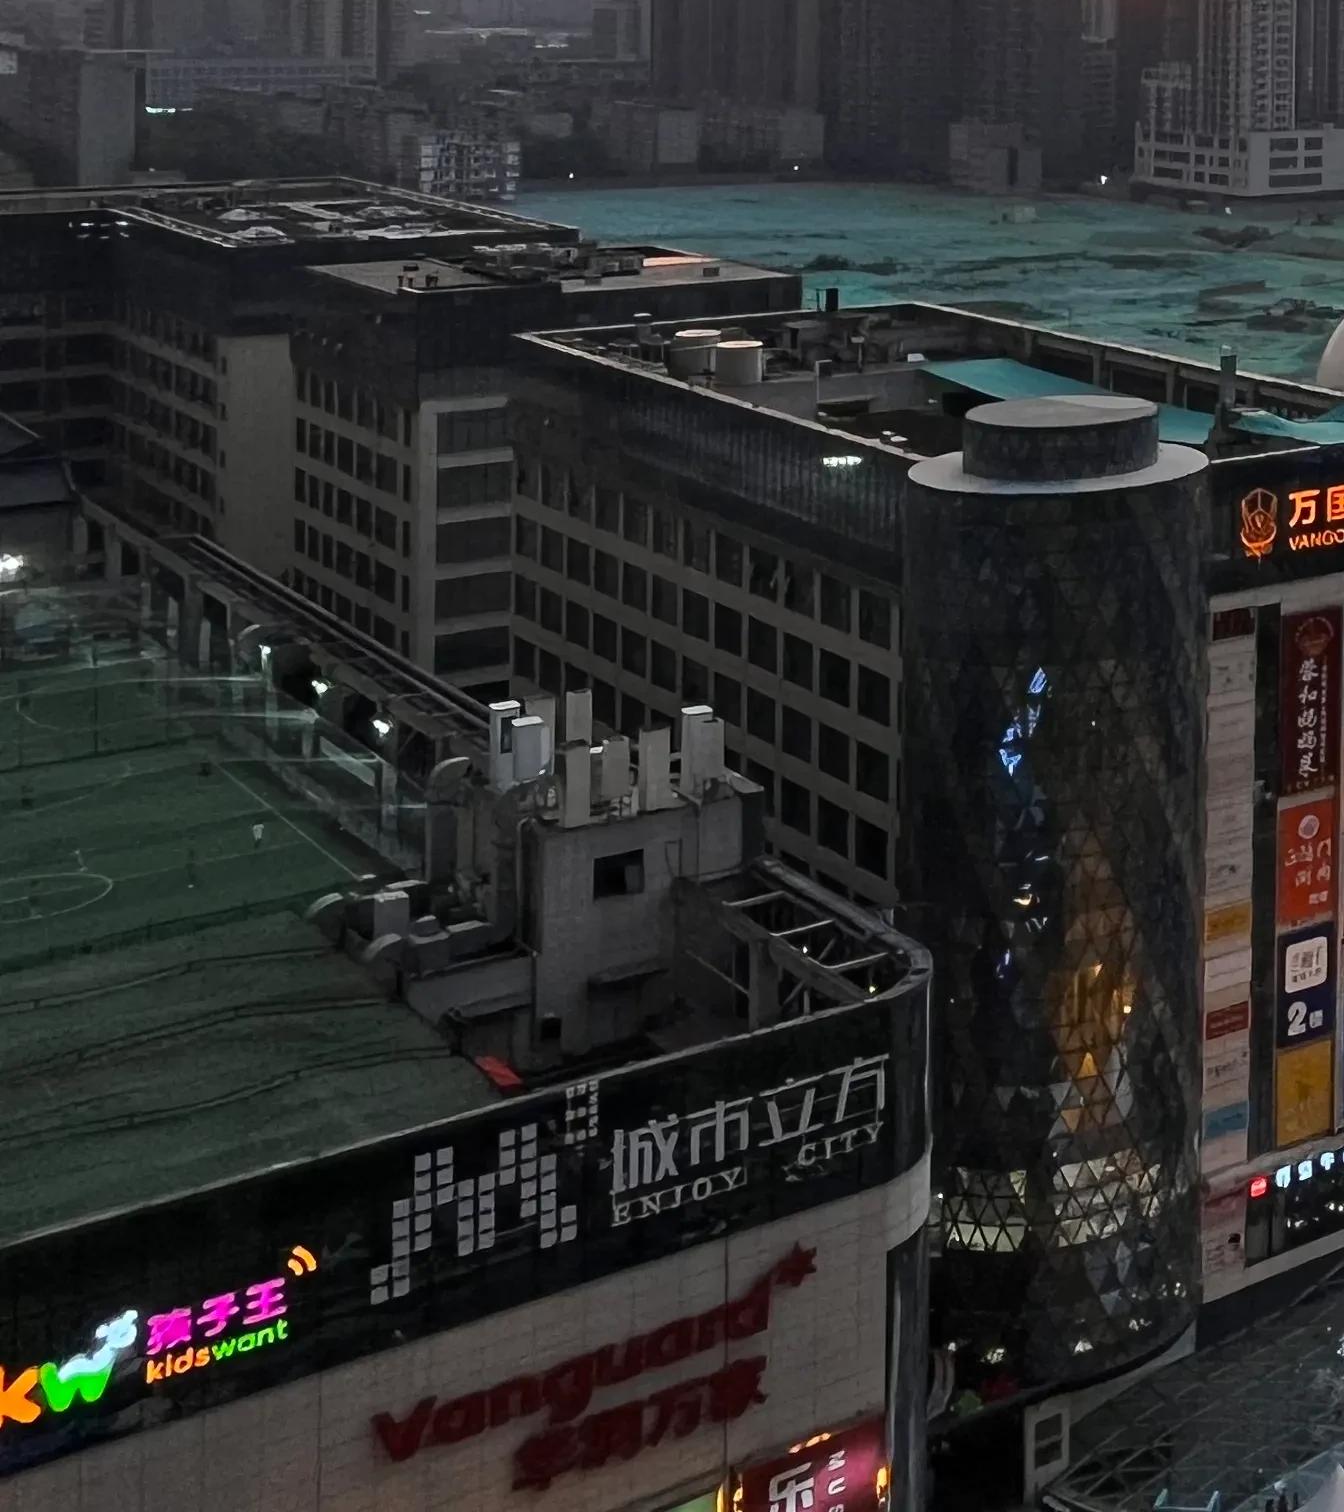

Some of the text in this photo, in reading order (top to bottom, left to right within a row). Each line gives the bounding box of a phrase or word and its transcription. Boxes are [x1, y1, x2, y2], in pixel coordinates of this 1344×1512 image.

[611, 1053, 889, 1193] 城市立方
[612, 1122, 885, 1226] ENJOY CITY
[147, 1277, 287, 1356] 孩子王
[147, 1318, 289, 1384] kidswant
[371, 1270, 771, 1462] Vanguard
